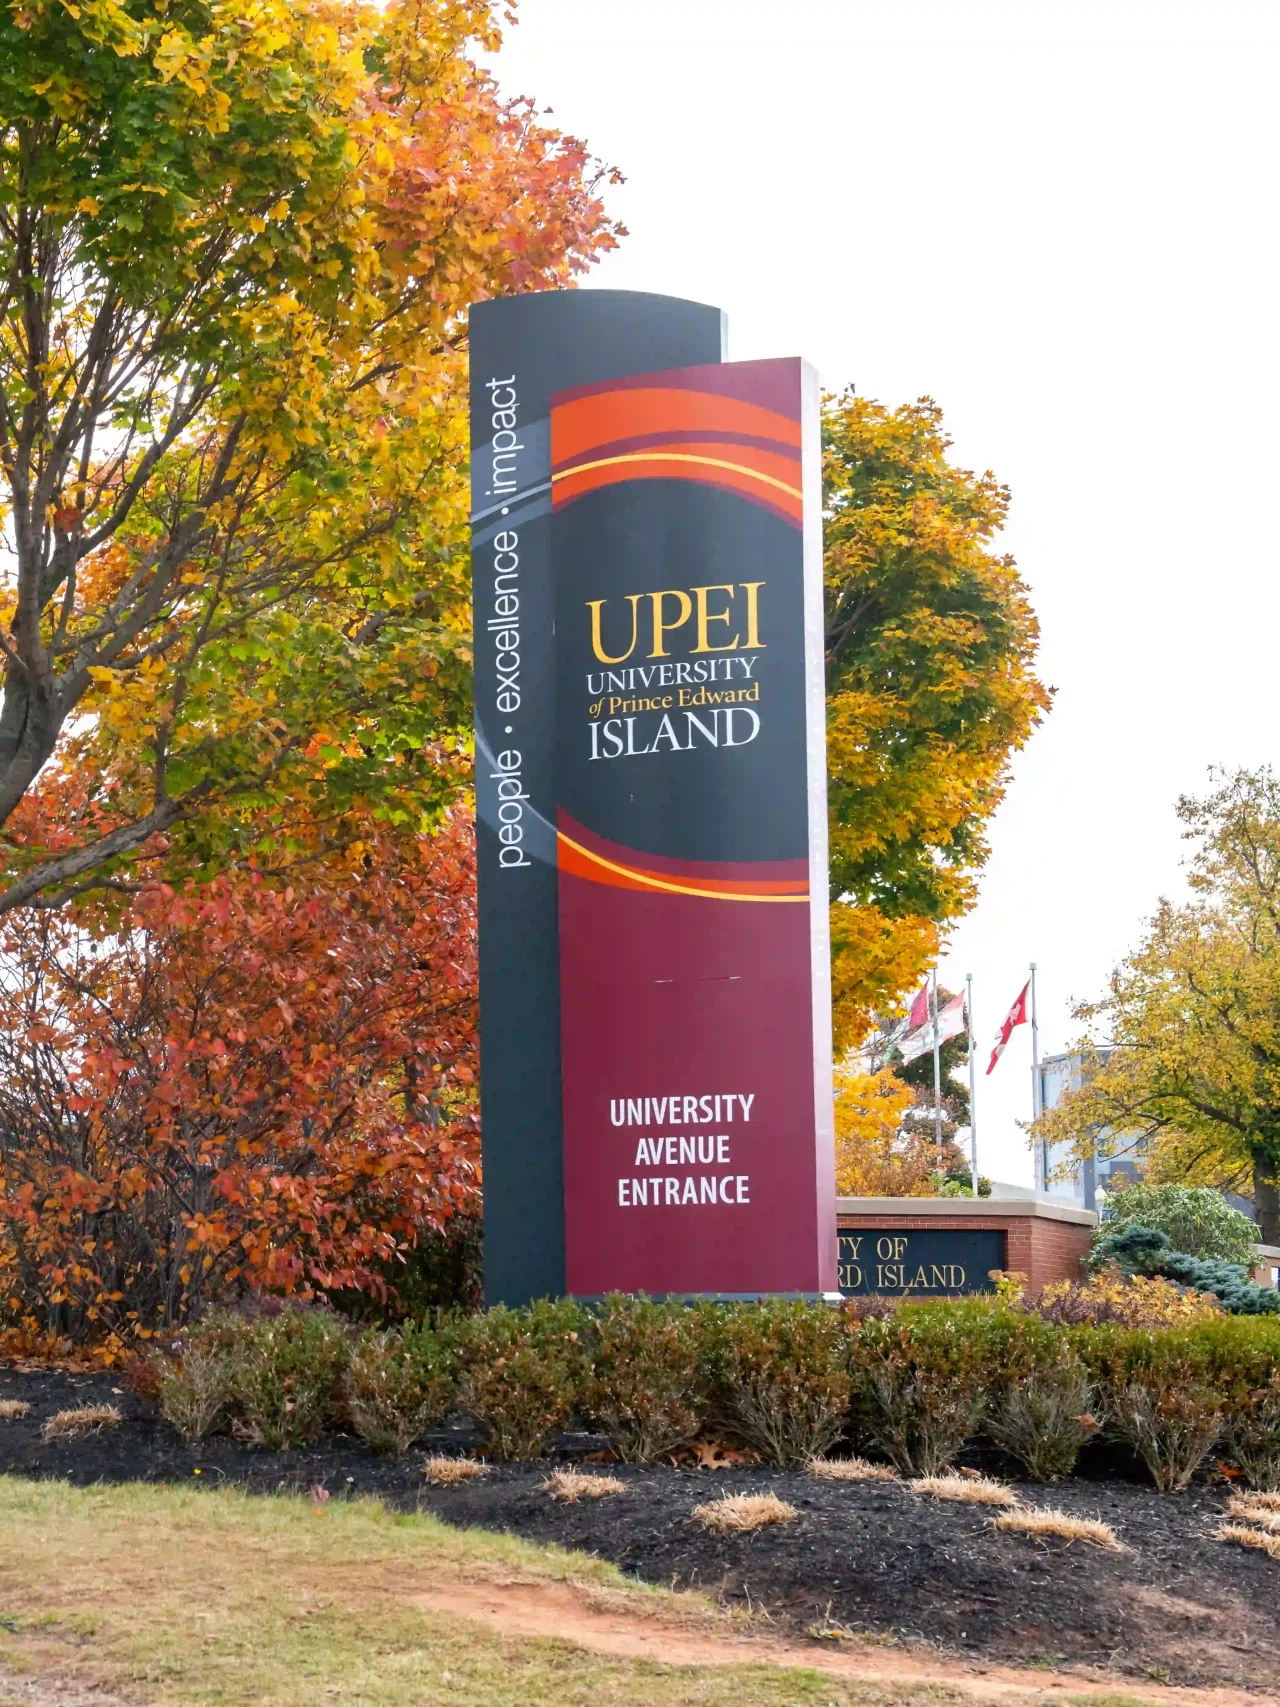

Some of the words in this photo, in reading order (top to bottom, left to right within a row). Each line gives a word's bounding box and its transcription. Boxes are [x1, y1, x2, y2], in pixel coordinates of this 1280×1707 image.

[485, 374, 524, 495] impact
[487, 531, 521, 713] excellence
[585, 582, 767, 664] UPEI
[586, 656, 759, 695] UNIVERSITY
[589, 697, 606, 718] of
[609, 694, 673, 715] Prince
[678, 682, 760, 707] Edward
[588, 707, 761, 760] ISLAND
[489, 749, 532, 868] people
[610, 1094, 755, 1126] UNIVERSITY
[635, 1135, 730, 1165] AVENUE
[618, 1176, 750, 1206] ENTRANCE
[876, 1237, 908, 1260] OF
[876, 1265, 966, 1288] ISLAND
